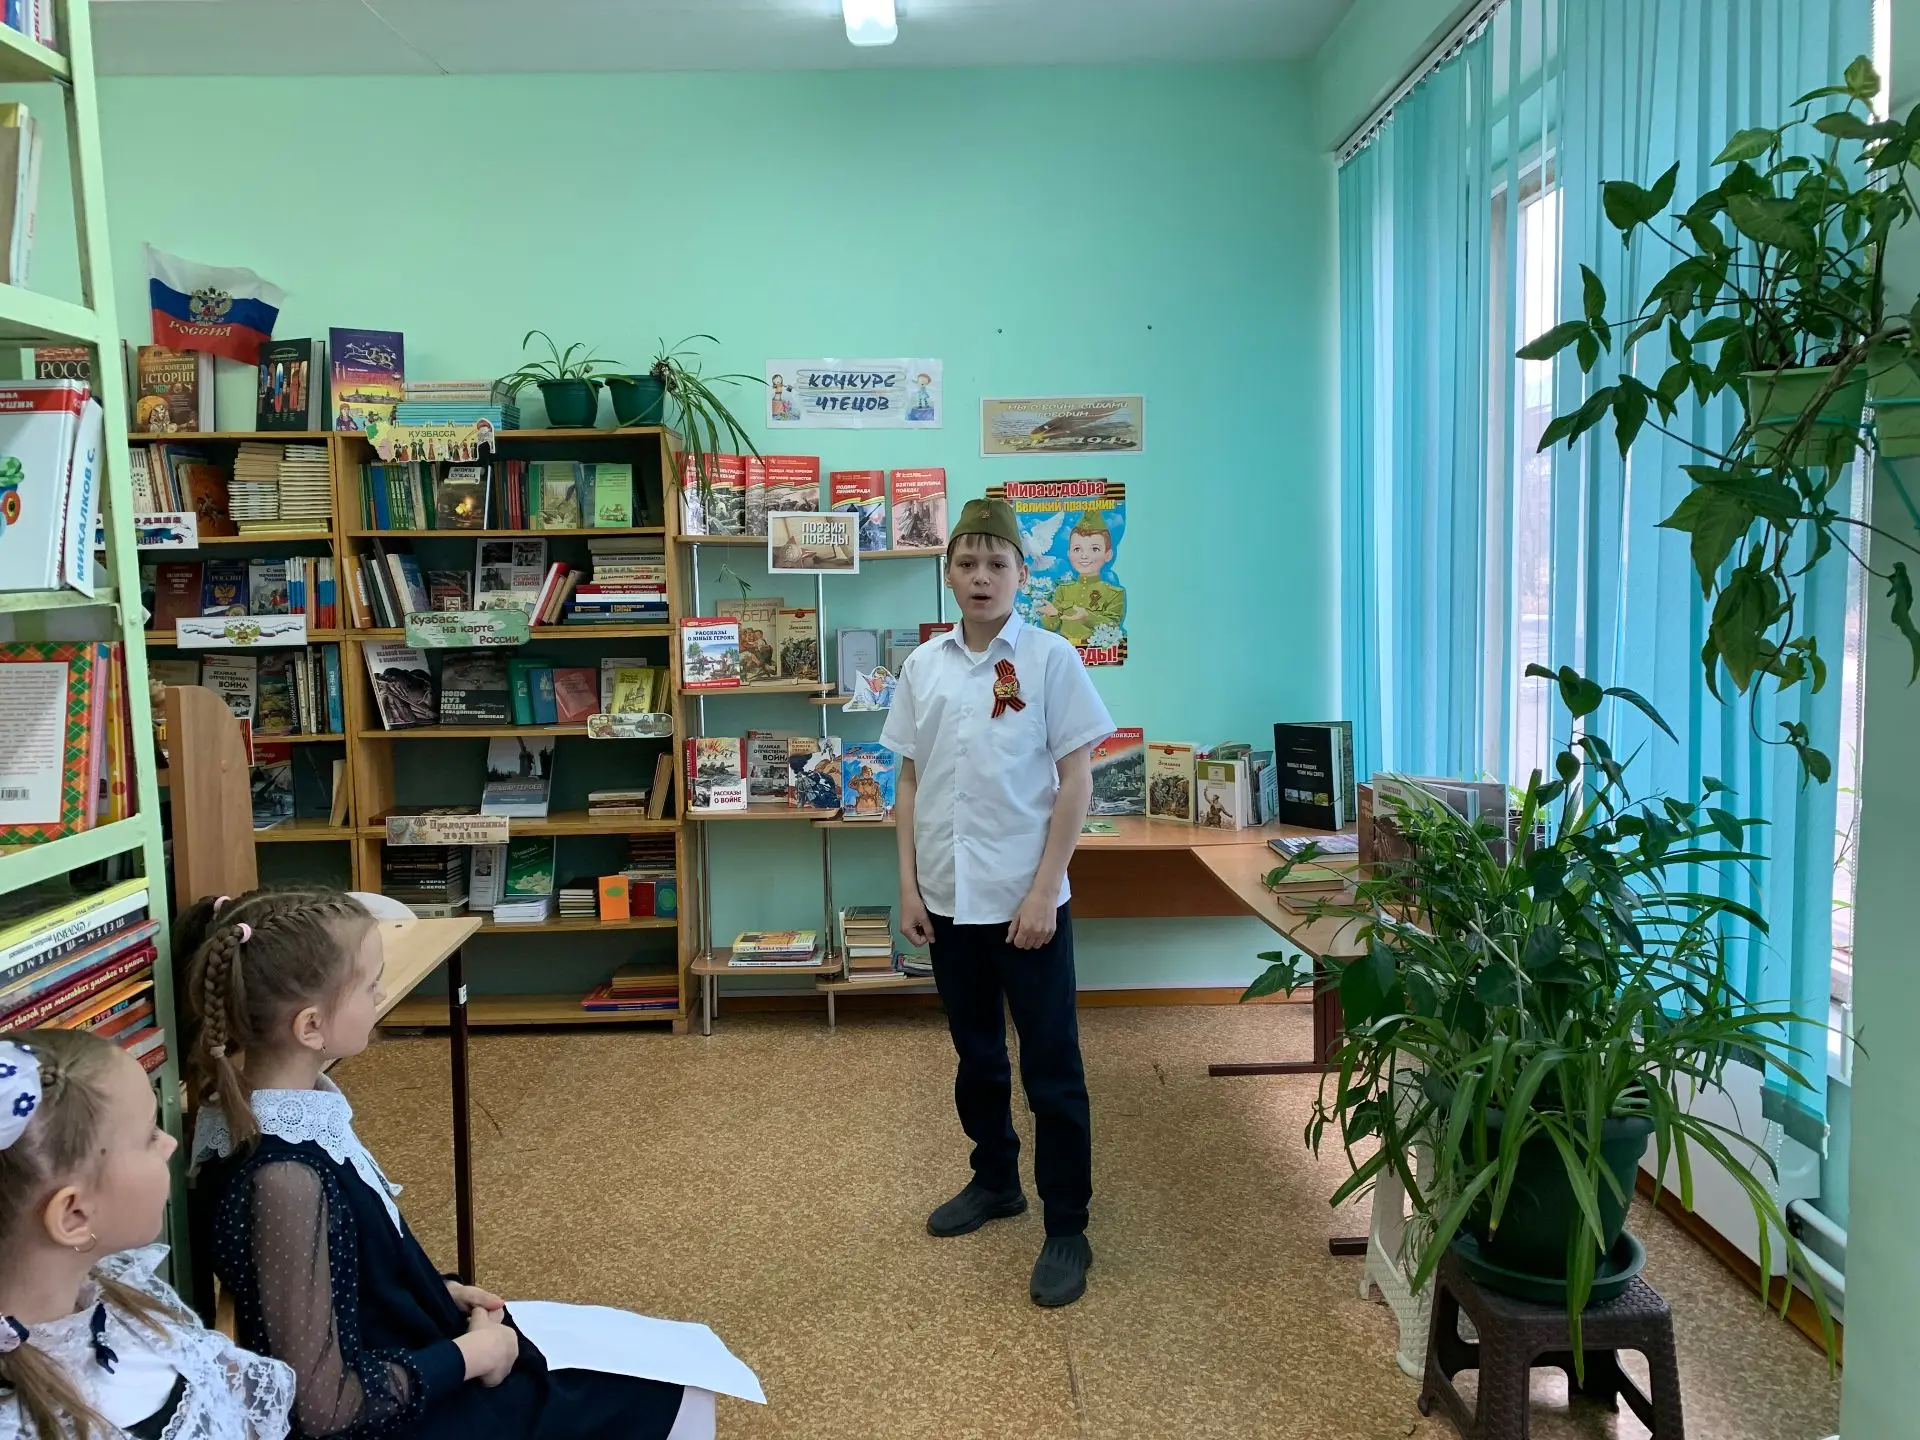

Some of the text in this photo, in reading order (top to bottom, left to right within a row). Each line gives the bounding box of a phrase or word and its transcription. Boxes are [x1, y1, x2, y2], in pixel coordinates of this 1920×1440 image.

[169, 320, 232, 337] РОССИЯ
[40, 361, 91, 379] РОСС
[808, 372, 896, 389] КОНКУРС
[815, 396, 890, 412] ЧТЕЦОВ
[408, 430, 456, 438] КУЗБАССА
[1007, 480, 1104, 498] Мира и добра
[1015, 500, 1062, 513] Великий
[1063, 498, 1115, 512] праздник
[77, 447, 96, 582] МИХАЛКОВ С.
[802, 521, 846, 534] ПОЭЗИЯ
[802, 533, 849, 546] ПОБЕДЫ
[410, 613, 460, 626] Кузбасс
[721, 609, 777, 621] ПОБЕДА
[442, 623, 495, 635] на карте
[479, 633, 520, 644] России
[1077, 644, 1118, 666] еды!
[218, 680, 248, 689] ВОЙНА
[516, 783, 542, 791] ГЕРОЕВ
[429, 819, 507, 831] Прадедушкины
